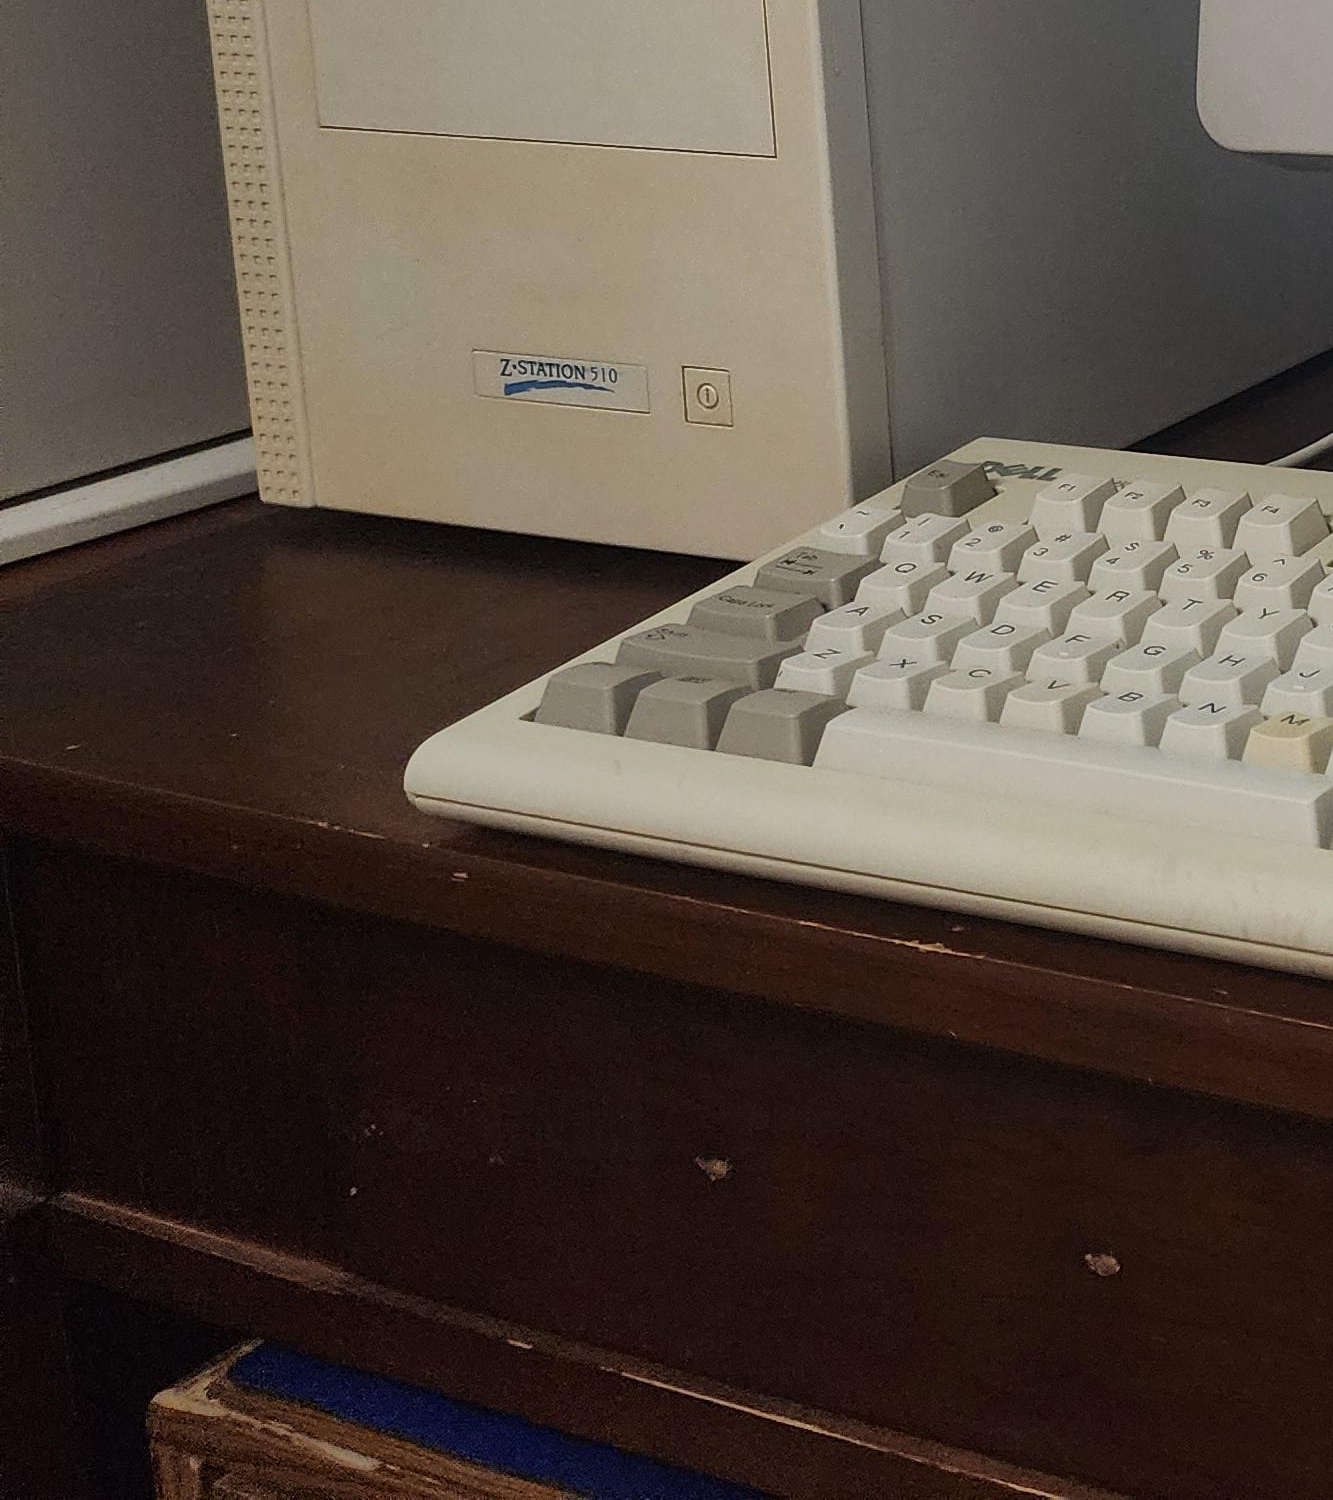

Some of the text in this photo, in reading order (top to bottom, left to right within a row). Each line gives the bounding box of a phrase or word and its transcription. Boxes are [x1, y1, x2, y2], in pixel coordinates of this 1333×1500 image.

[589, 366, 618, 384] 510
[964, 537, 982, 548] 2
[1032, 546, 1049, 557] 3
[1104, 555, 1121, 567] 4
[894, 562, 918, 574] Q
[1177, 562, 1193, 574] 5
[963, 570, 994, 584] W
[1251, 572, 1269, 583] 6
[1032, 580, 1059, 593] E
[1105, 590, 1131, 603] R
[1181, 598, 1204, 611] T
[846, 605, 871, 618] A
[1257, 606, 1281, 620] Y
[919, 613, 944, 625] S
[990, 623, 1017, 636] D
[1064, 634, 1092, 646] F
[813, 648, 842, 661] Z
[1143, 644, 1168, 657] G
[889, 657, 919, 669] X
[1218, 653, 1247, 668] H
[968, 668, 992, 679] C
[1299, 668, 1321, 679] J
[1047, 679, 1071, 690] V
[1117, 691, 1145, 702] B
[1197, 701, 1228, 714] N
[1279, 714, 1312, 726] M
